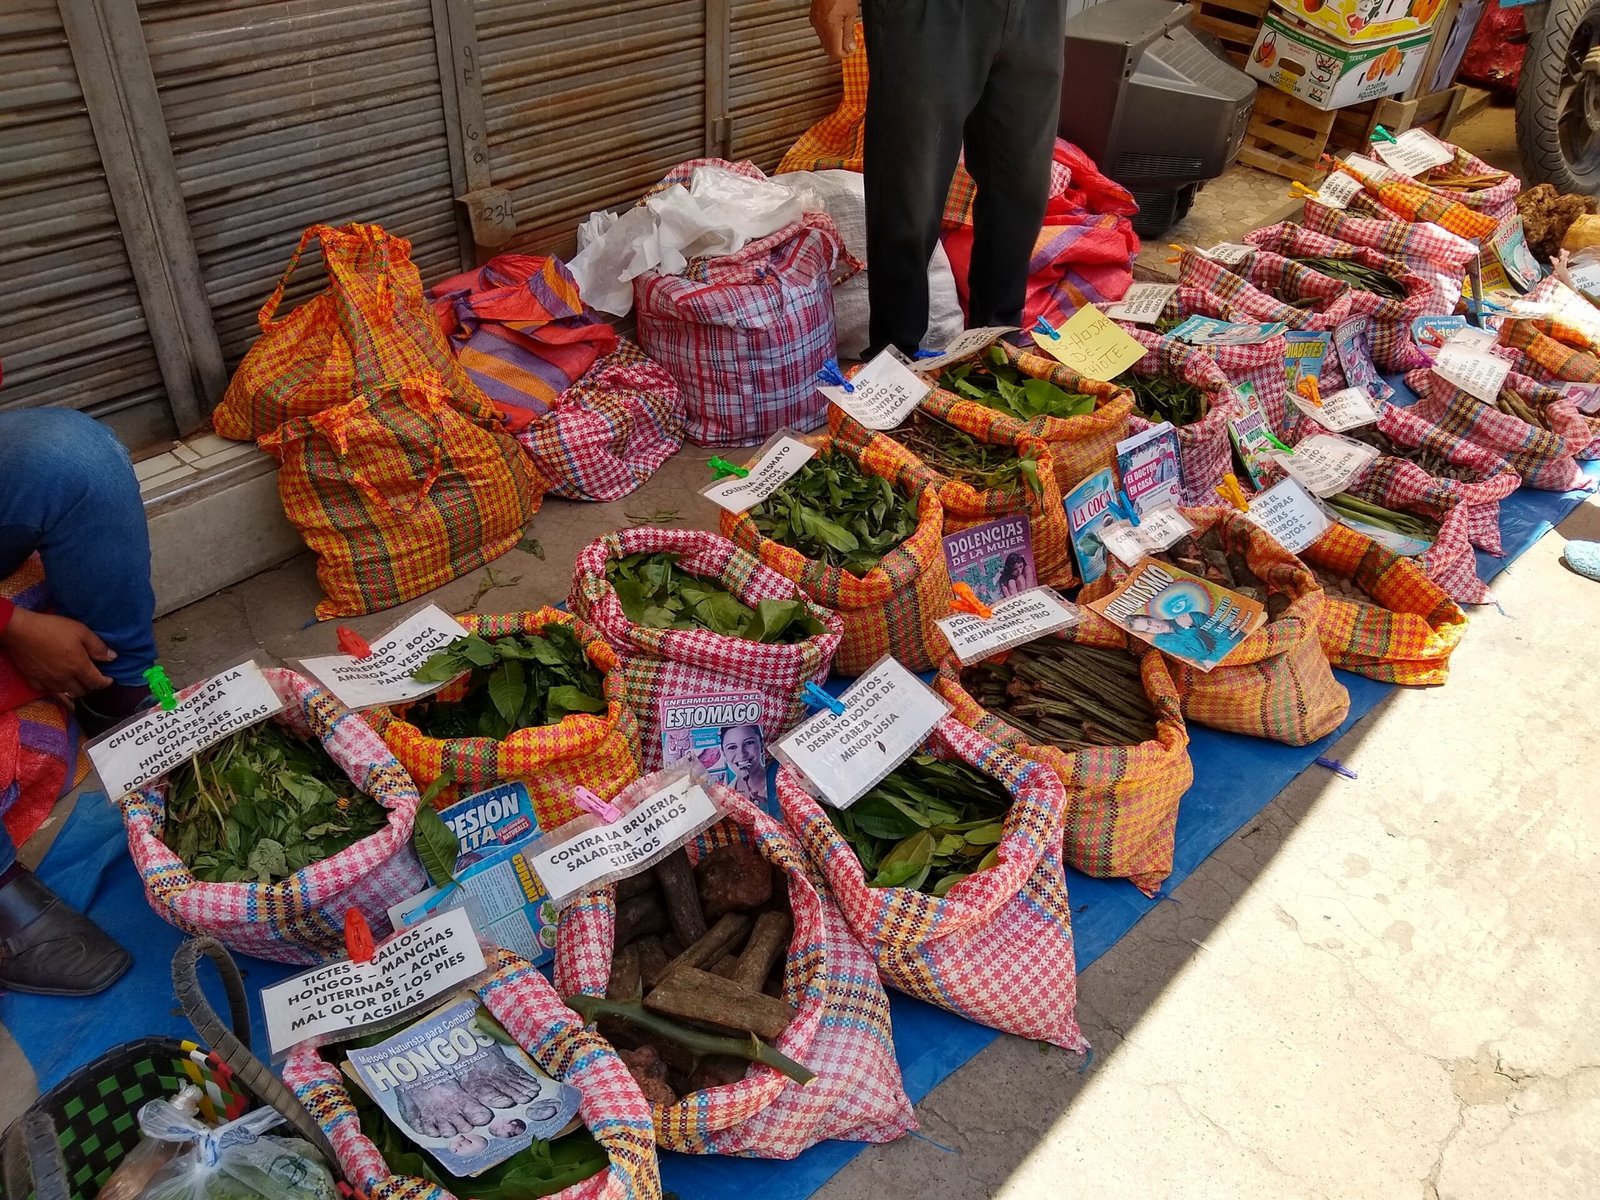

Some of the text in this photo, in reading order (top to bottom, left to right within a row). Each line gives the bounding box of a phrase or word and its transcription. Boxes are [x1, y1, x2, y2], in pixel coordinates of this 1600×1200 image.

[1286, 341, 1327, 360] DIABETES
[856, 378, 871, 391] DEL
[894, 384, 905, 394] EL
[759, 446, 790, 478] DESMAYO
[1127, 461, 1158, 485] EL DOCTOR
[751, 468, 781, 494] NERVIOS
[757, 470, 791, 499] CORAZON
[1129, 485, 1139, 497] EN
[1137, 477, 1155, 493] CASA
[1072, 509, 1087, 529] LA
[1086, 490, 1113, 518] COCA
[1250, 494, 1280, 515] PARA EL
[1258, 495, 1295, 521] COMPRAS
[1260, 511, 1289, 530] VENTAS
[949, 521, 1024, 558] DOLENCIAS
[1270, 516, 1299, 537] CARROS
[952, 555, 967, 567] DE
[969, 548, 984, 560] LA
[986, 535, 1025, 554] MUJER
[1104, 564, 1175, 624] REUMATISMO
[998, 601, 1045, 623] CALAMBRES
[1030, 610, 1050, 621] FRIO
[1200, 596, 1233, 632] TRATAMIENTO
[1214, 606, 1242, 635] NATURISTA
[332, 626, 437, 675] SOBREPESO BOCA
[337, 632, 449, 683] AMARGA VESICULA
[351, 641, 397, 667] HIGADO
[108, 670, 242, 750] CHUPA SANGRE DE LA
[664, 693, 762, 706] ENFERMEDADES DEL
[664, 701, 762, 730] ESTOMAGO
[794, 717, 831, 748] ATAQUE
[843, 676, 883, 713] NERVIOS
[135, 690, 227, 747] CELULA PARA
[156, 716, 206, 746] GOLPES
[806, 680, 897, 754] DESMAYO DOLOR DE
[839, 718, 873, 746] CABEZA
[123, 704, 268, 792] DOLORES FRACTURAS
[138, 710, 231, 770] HINCHAZONES
[840, 713, 900, 763] MENOPAUSIA
[457, 825, 497, 858] LTA
[502, 821, 530, 842] NATURALES
[550, 793, 680, 866] CONTRA LA BRUJERIA
[567, 803, 688, 873] SALADERA MALOS
[610, 836, 662, 868] SUEÑOS
[288, 927, 454, 1006] HONGOS MANCHAS
[302, 929, 421, 987] TICTES CALLOS
[316, 944, 449, 1006] UTERINAS ACNE
[290, 952, 466, 1031] MAL OLOR DE LOS PIES
[345, 989, 426, 1026] Y ACSILAS
[388, 1034, 426, 1057] Naturista
[424, 1026, 444, 1042] para
[442, 1006, 477, 1031] Combatir
[363, 1018, 497, 1093] HONGOS
[453, 1051, 489, 1071] BACTERIAS
